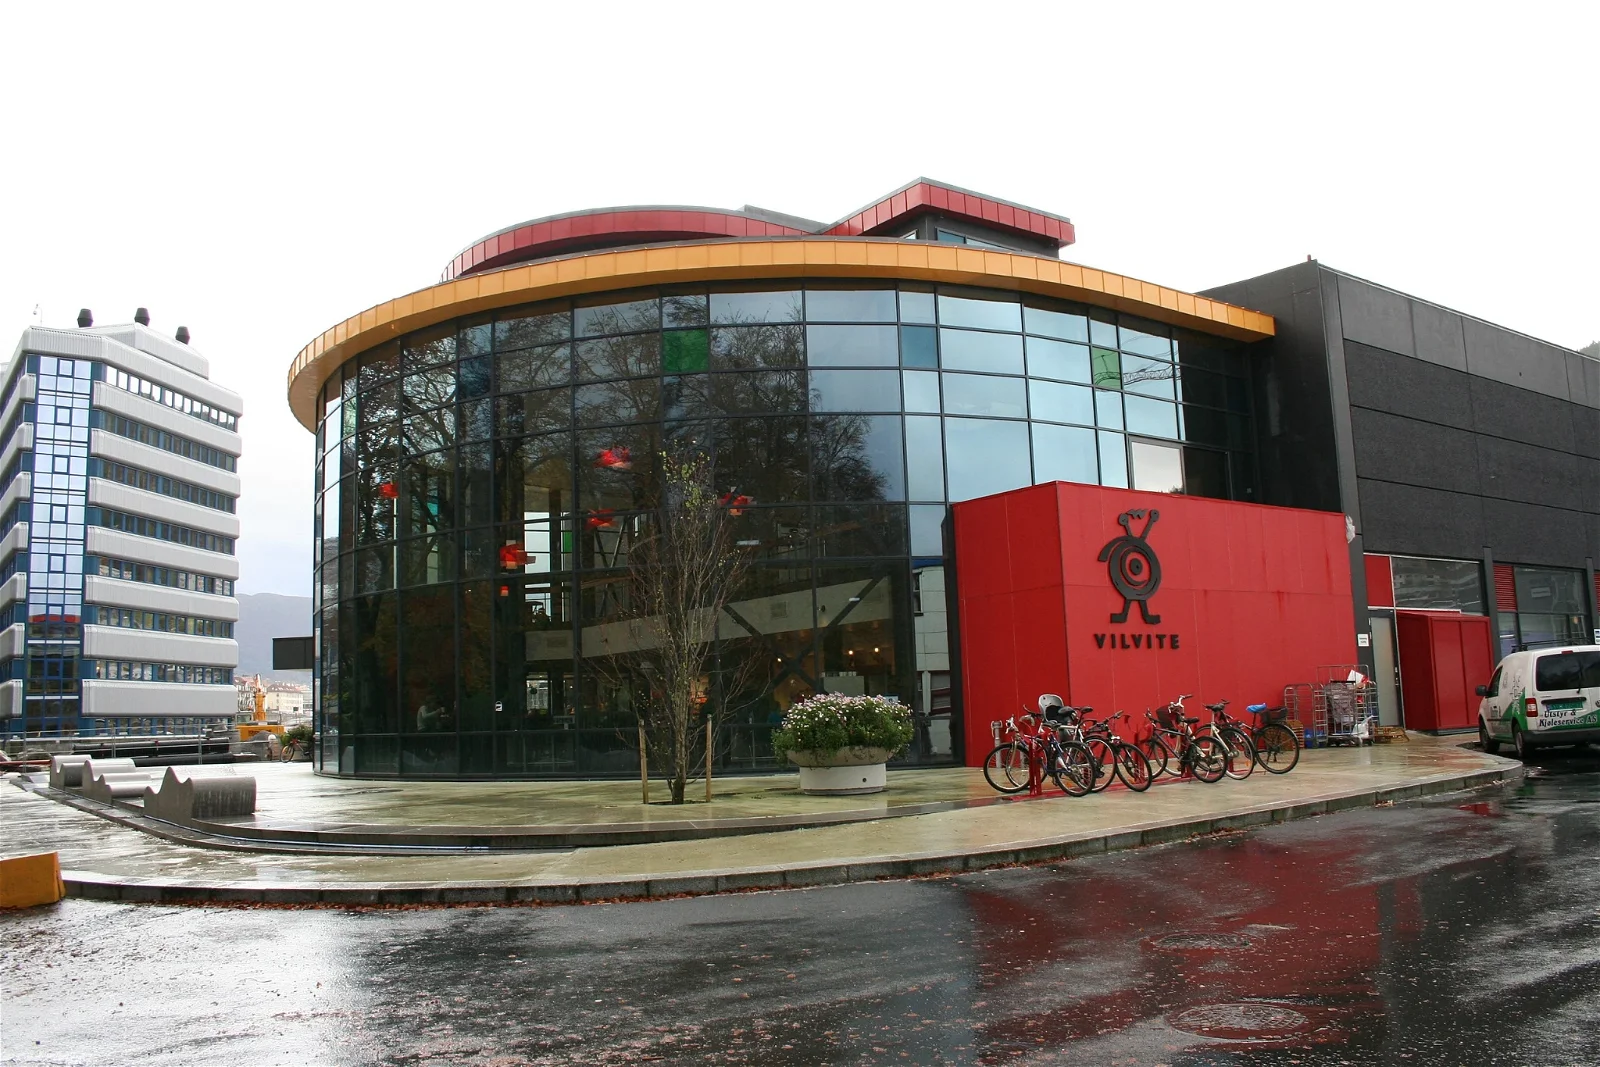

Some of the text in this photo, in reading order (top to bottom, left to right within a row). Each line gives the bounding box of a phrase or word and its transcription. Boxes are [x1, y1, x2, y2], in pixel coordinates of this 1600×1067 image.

[1093, 633, 1180, 650] VILVITE
[1544, 710, 1567, 718] Utstyr
[1586, 715, 1597, 723] AS
